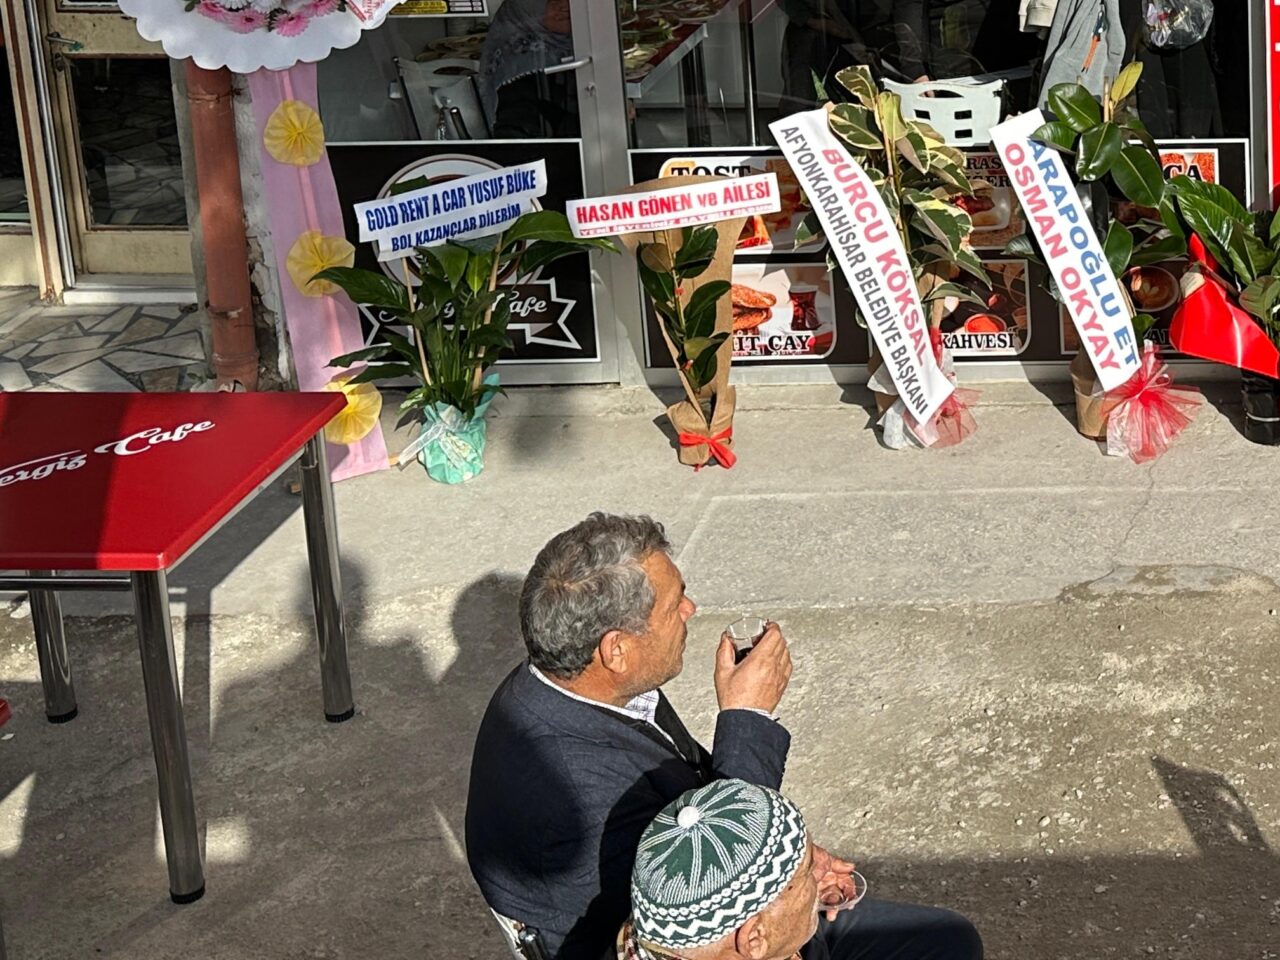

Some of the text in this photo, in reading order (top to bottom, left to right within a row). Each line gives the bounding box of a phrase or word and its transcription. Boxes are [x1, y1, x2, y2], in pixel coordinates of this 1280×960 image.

[365, 169, 536, 232] GOLD RENT A CAR YUSUF BÜKE
[576, 176, 771, 224] HASAN GÖNEN ve AİLESİ
[391, 203, 521, 252] BOL KAZANÇLAR DİLERİM
[781, 126, 929, 415] AFYONKARAHİSAR BELEDİYE BAŞKANI
[821, 149, 928, 367] BURCU KÖKSAL
[1004, 142, 1121, 371] OSMAN OKYAY
[1113, 325, 1138, 366] ET
[94, 420, 216, 457] Cafe
[0, 449, 87, 487] ergiz
